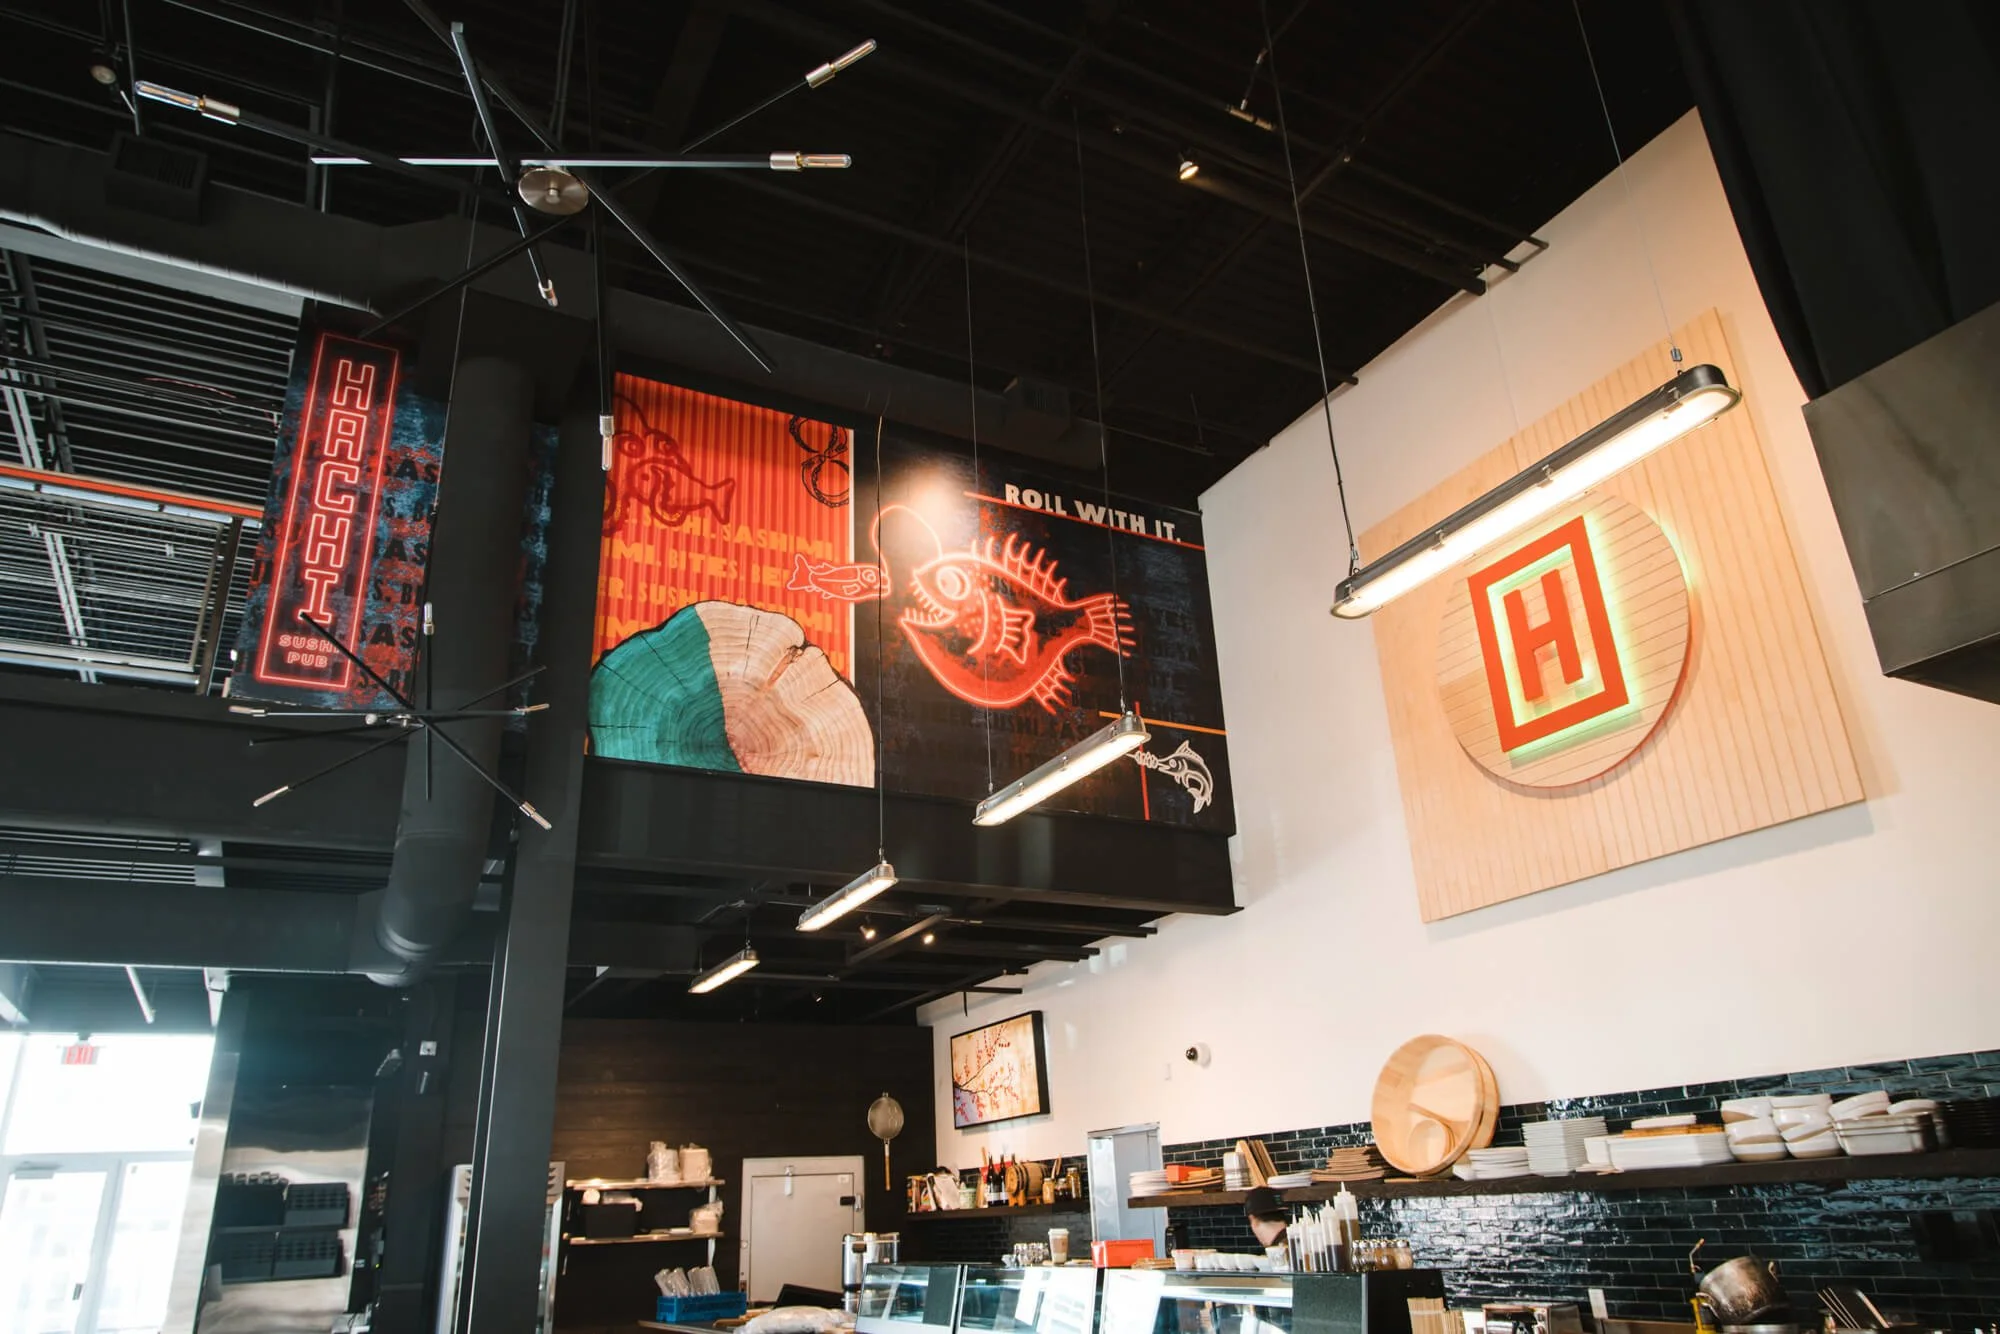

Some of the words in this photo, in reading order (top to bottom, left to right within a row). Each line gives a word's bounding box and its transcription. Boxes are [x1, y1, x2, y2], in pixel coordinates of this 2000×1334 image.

[298, 358, 375, 625] HACHI
[1005, 483, 1067, 517] ROLL
[1074, 500, 1146, 535] WITH
[1155, 519, 1182, 543] IT.
[722, 523, 839, 563] SASHIMI.
[668, 548, 745, 584] BITES.
[1504, 570, 1583, 702] H
[287, 650, 329, 669] PUB
[65, 1045, 95, 1065] EXIT
